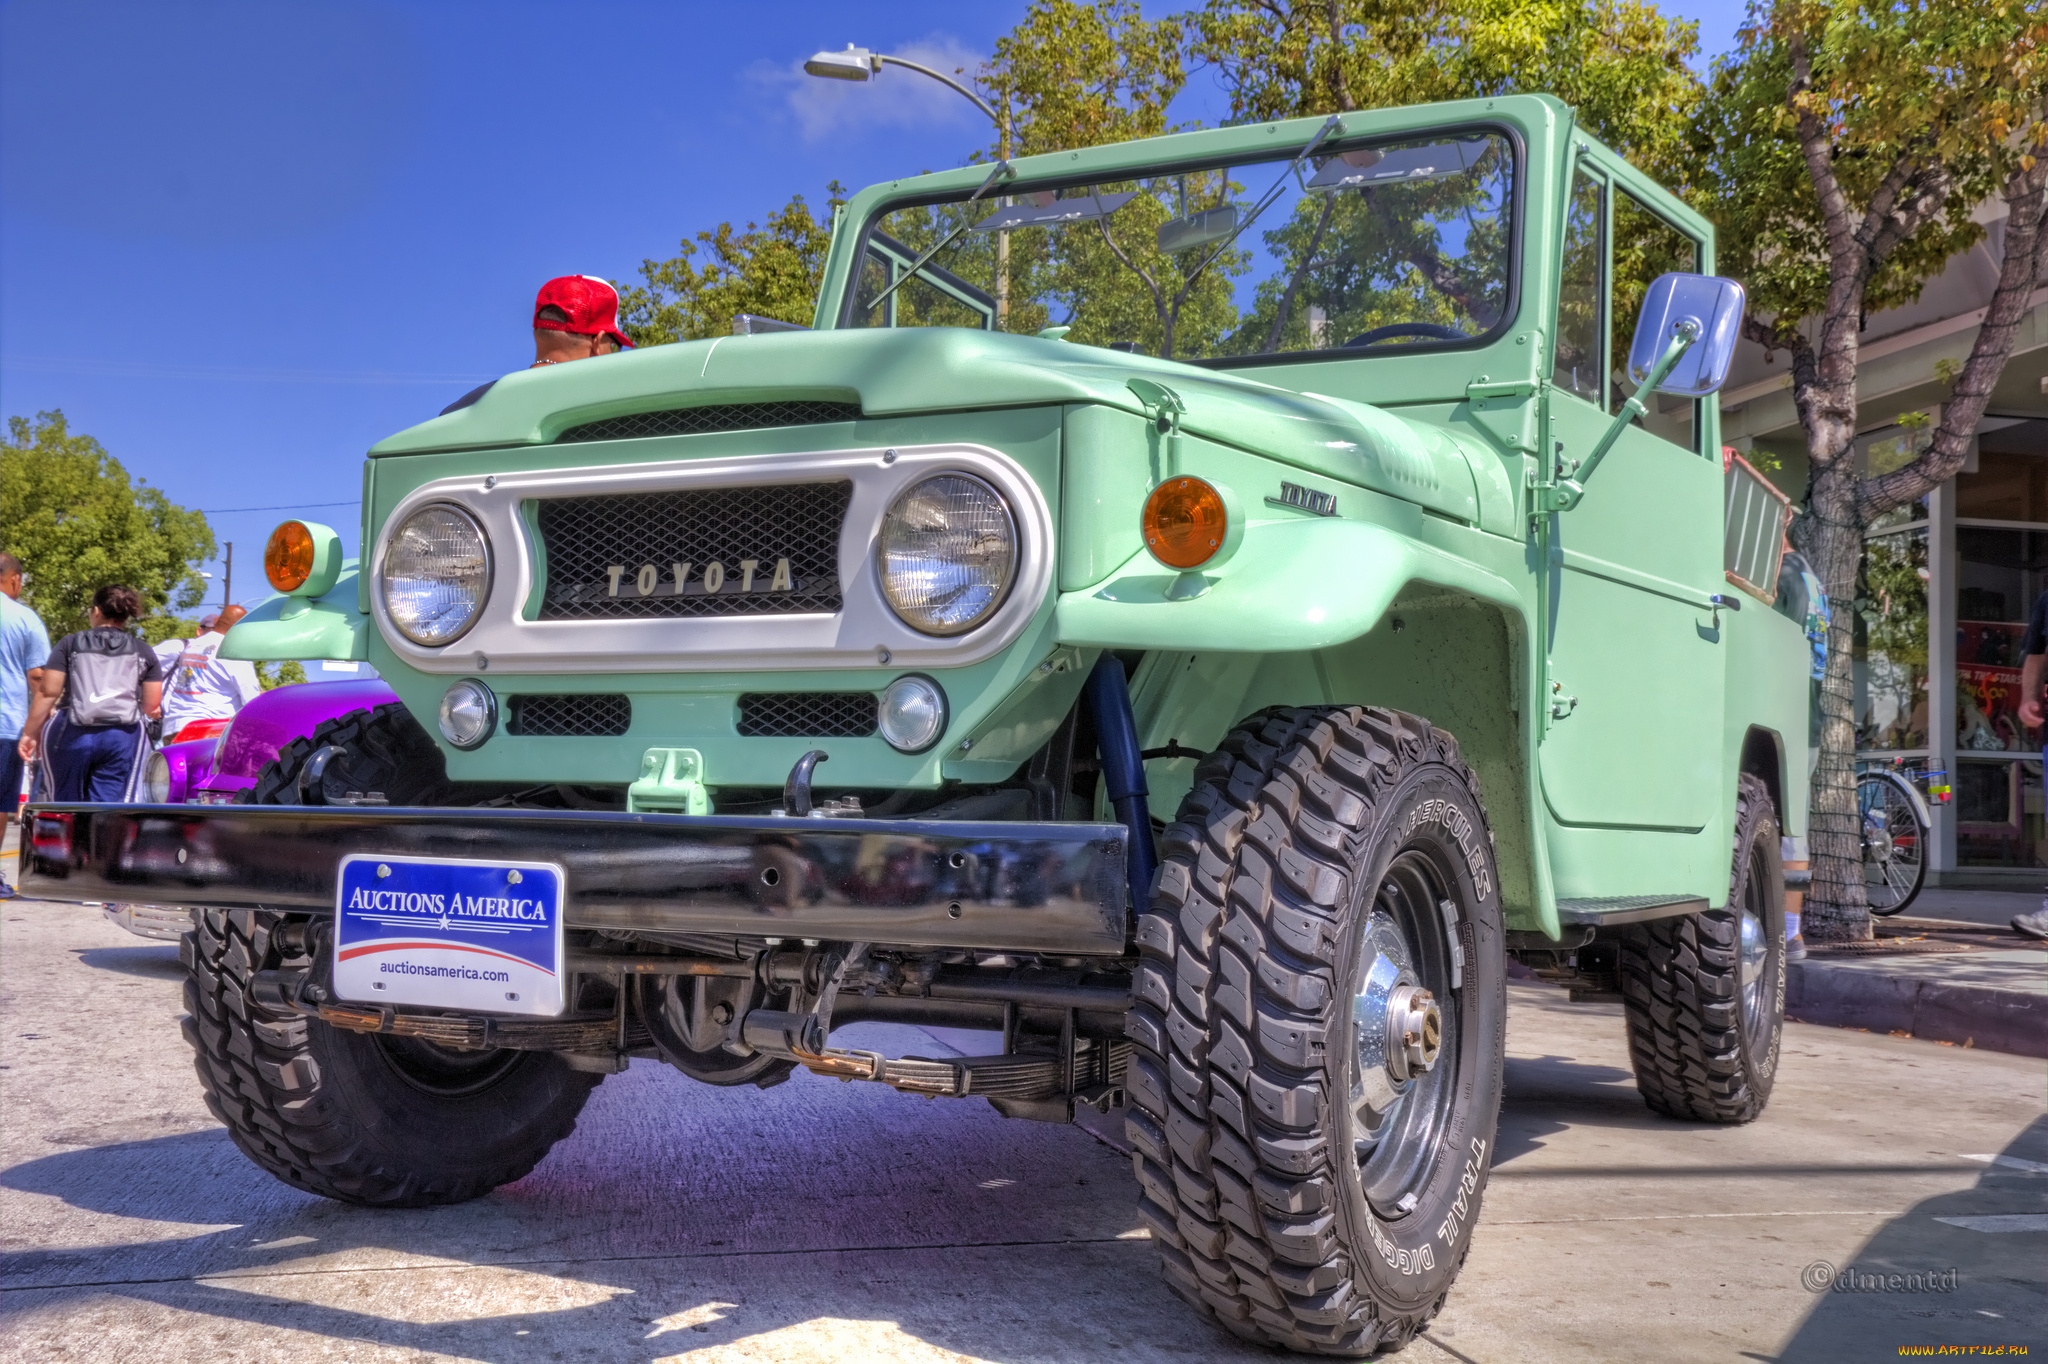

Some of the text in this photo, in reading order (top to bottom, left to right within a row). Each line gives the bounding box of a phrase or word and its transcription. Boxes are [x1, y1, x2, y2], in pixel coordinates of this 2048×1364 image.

[1280, 481, 1337, 516] TOYOTA
[607, 558, 792, 597] TOYOTA
[1406, 799, 1491, 901] HERCULES
[348, 886, 547, 921] AUCTIONS AMERICA
[380, 961, 509, 983] auctionsamerica.com
[1438, 1137, 1486, 1247] TRAIL
[1365, 1203, 1435, 1275] DIGGER
